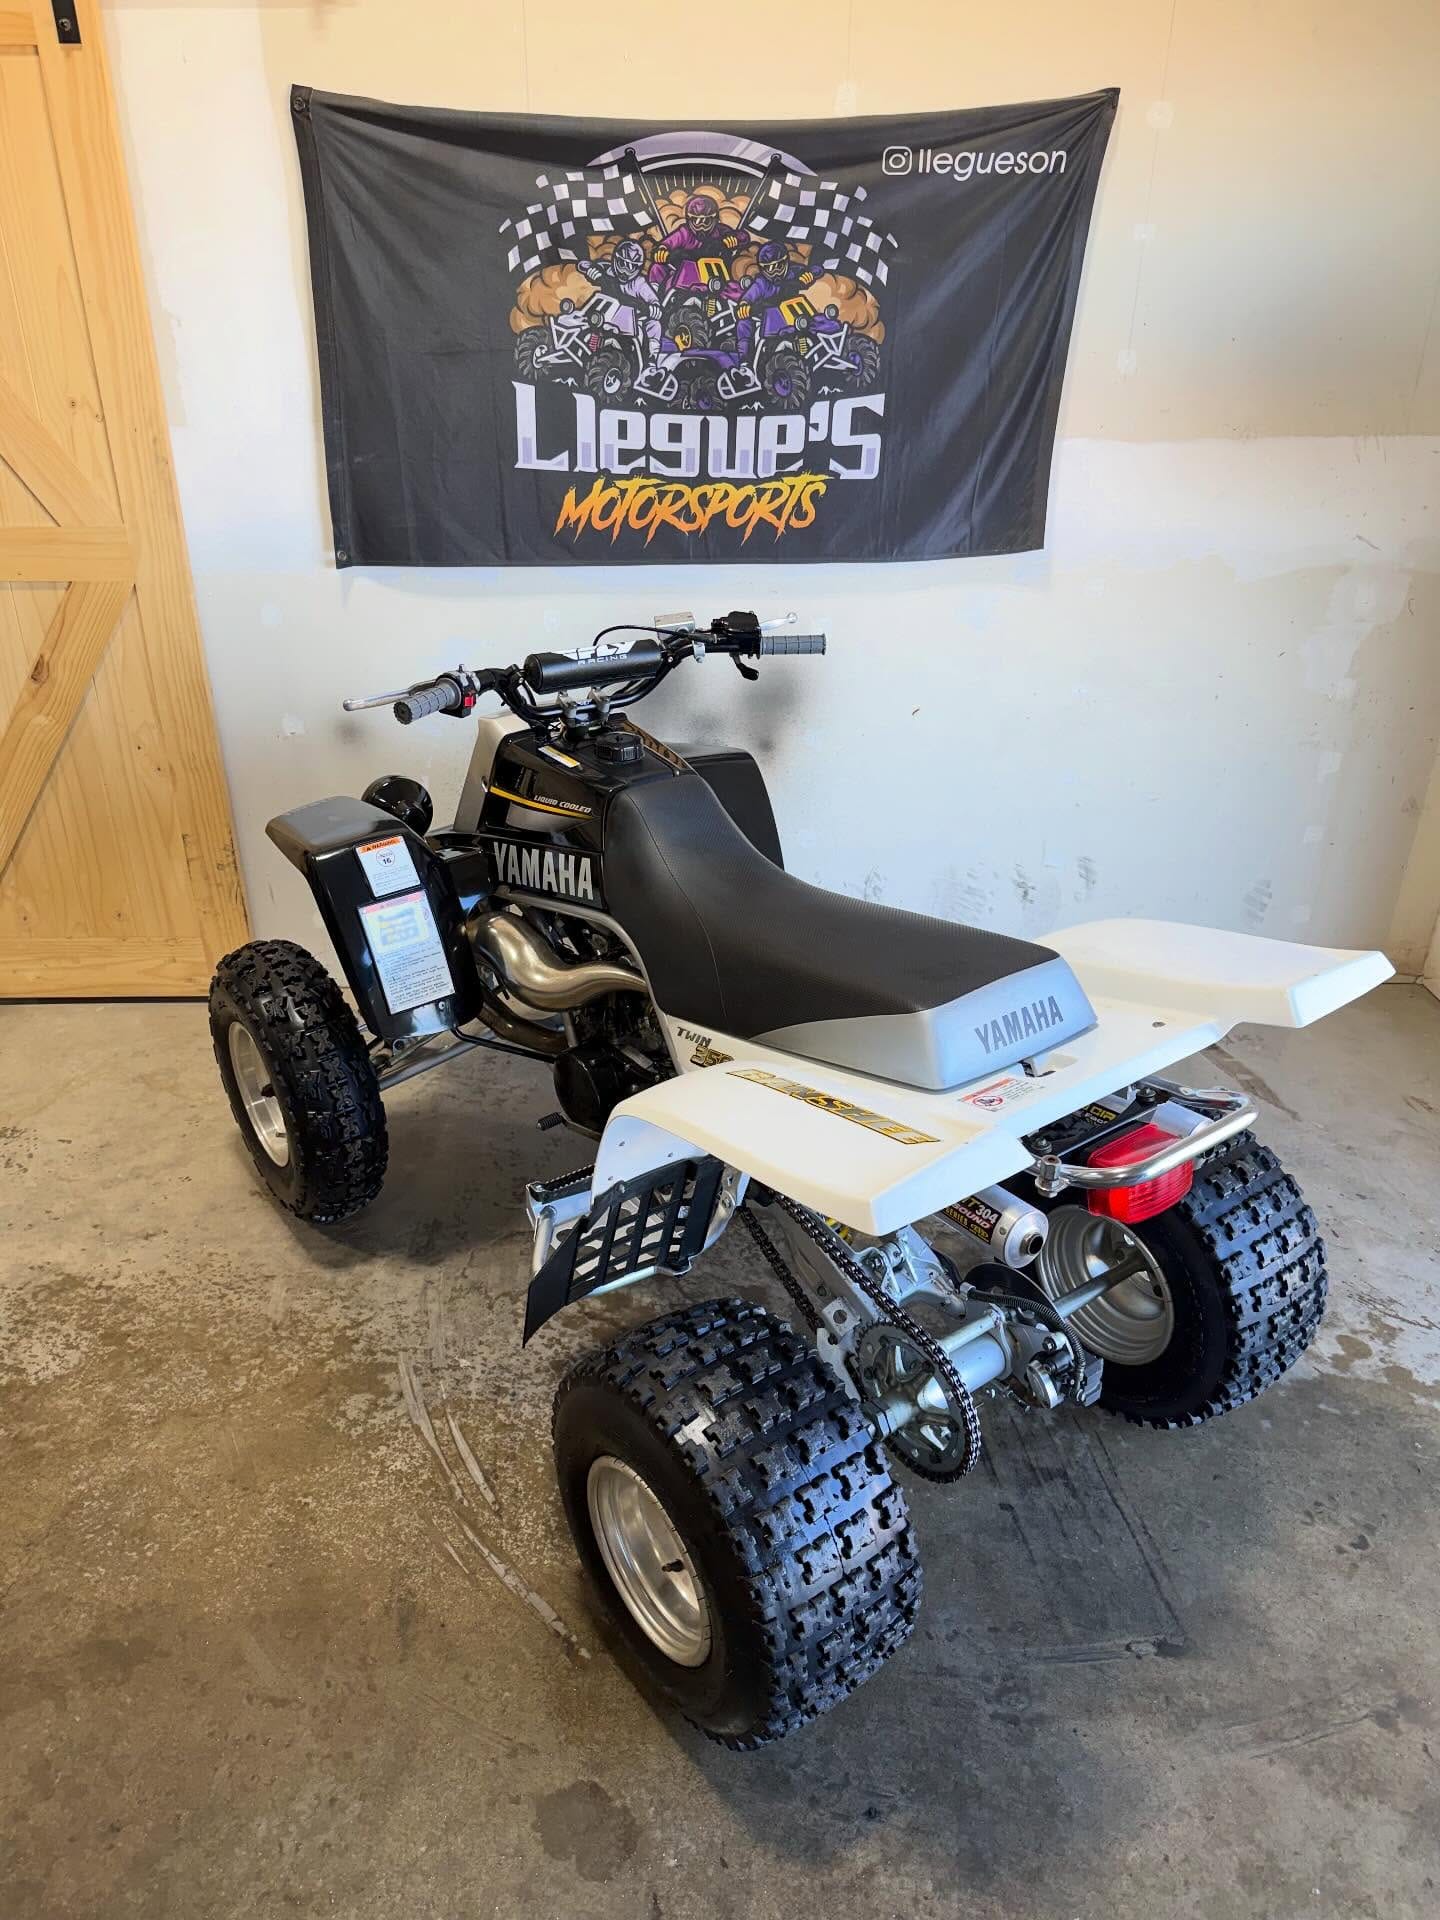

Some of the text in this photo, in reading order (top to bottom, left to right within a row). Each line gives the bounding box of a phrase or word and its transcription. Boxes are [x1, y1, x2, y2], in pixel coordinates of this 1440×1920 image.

[918, 149, 1067, 181] llegueson
[554, 473, 834, 548] MOTORSPORTS
[577, 654, 628, 665] RACING
[534, 795, 592, 814] LIQUID COOLED
[493, 841, 594, 900] YAMAHA
[677, 1026, 712, 1047] TWIN
[974, 995, 1064, 1054] YAMAHA
[975, 1205, 999, 1224] 304
